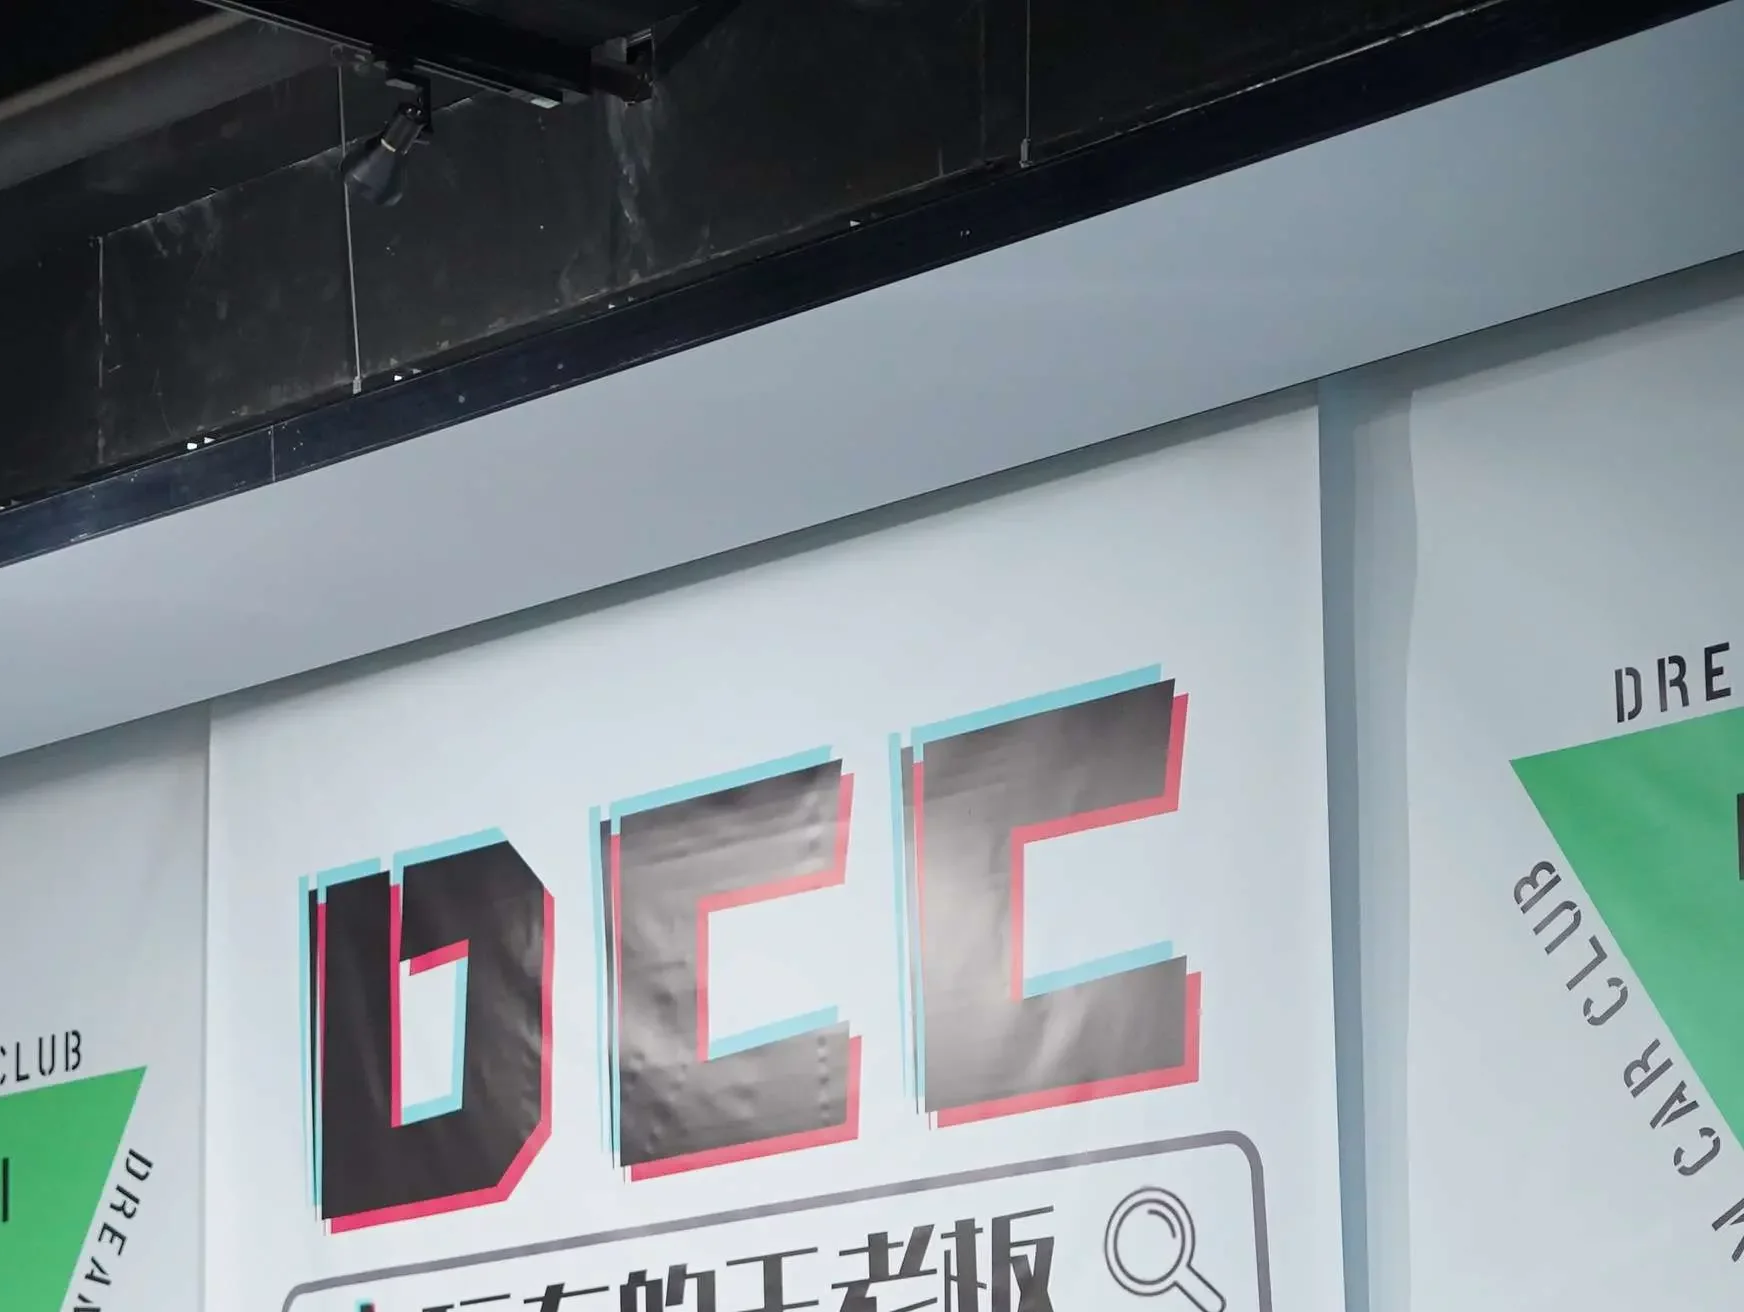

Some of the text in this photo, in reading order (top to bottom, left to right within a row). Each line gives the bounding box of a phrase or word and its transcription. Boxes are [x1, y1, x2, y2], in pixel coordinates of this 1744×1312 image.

[299, 663, 1201, 1235] DCC
[1513, 861, 1722, 1177] CAR CLUB
